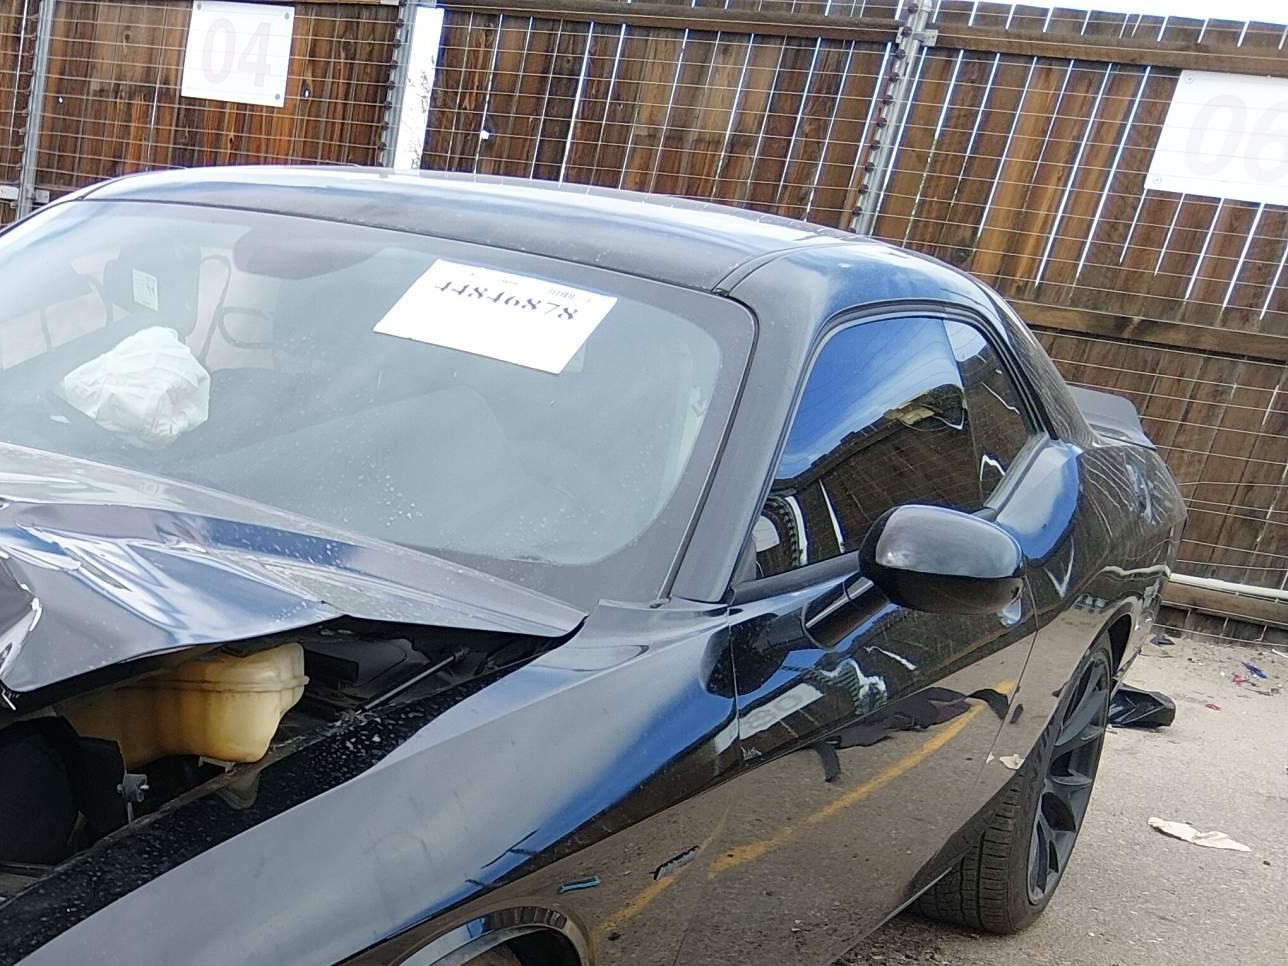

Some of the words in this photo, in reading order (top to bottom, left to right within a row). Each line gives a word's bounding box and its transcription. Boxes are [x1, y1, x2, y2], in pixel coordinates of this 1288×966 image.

[202, 18, 272, 88] 04
[1184, 94, 1288, 182] 06
[434, 280, 579, 321] 44846878
